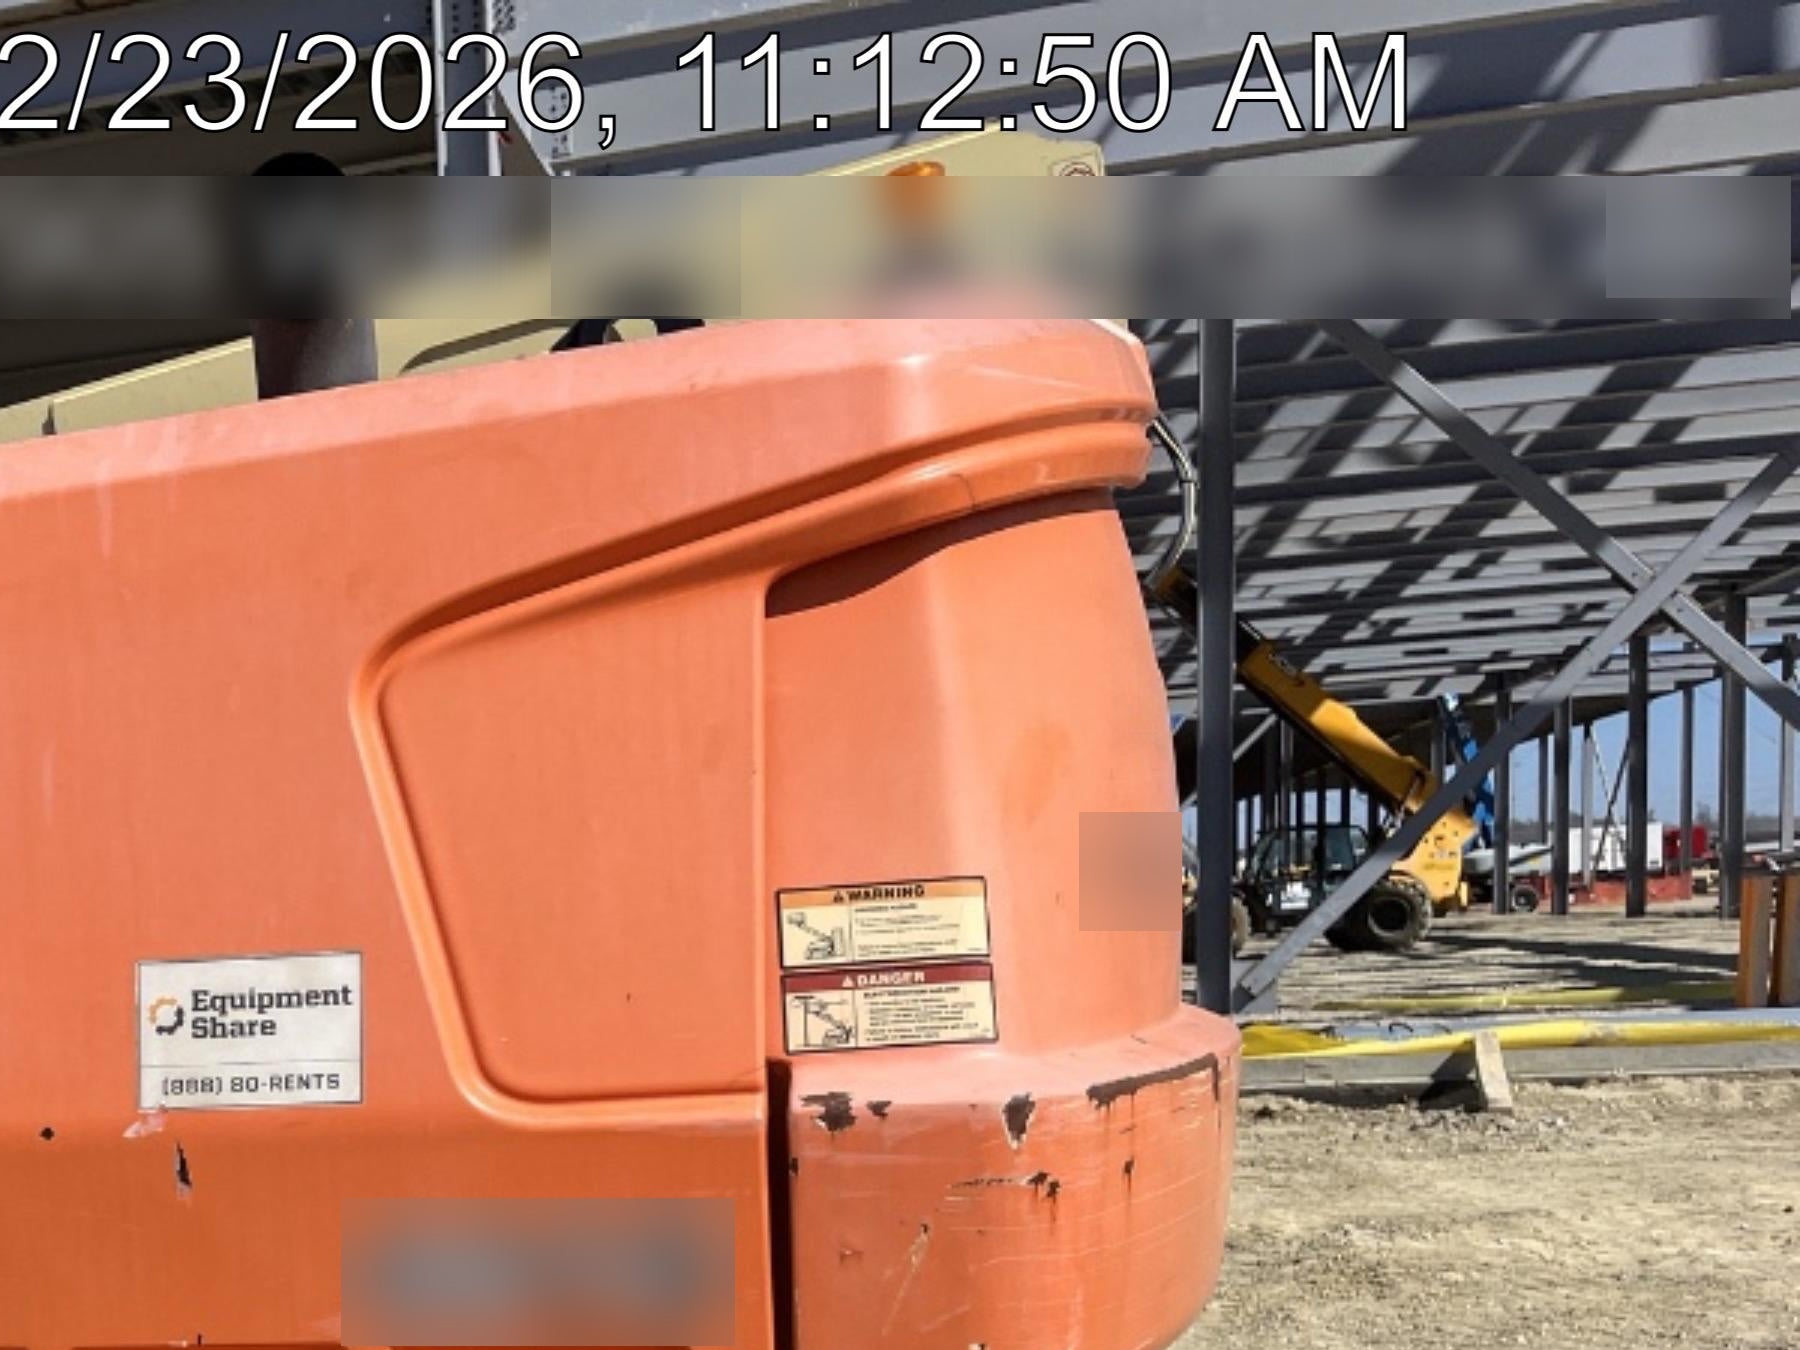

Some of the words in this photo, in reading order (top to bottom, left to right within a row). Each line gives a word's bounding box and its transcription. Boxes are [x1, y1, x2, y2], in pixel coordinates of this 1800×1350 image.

[846, 884, 925, 901] WARNING
[856, 970, 926, 987] DANGER
[191, 984, 353, 1017] Equipment
[191, 1016, 277, 1039] Share
[161, 1076, 223, 1096] (888)
[230, 1073, 341, 1093] 80-RENTS
